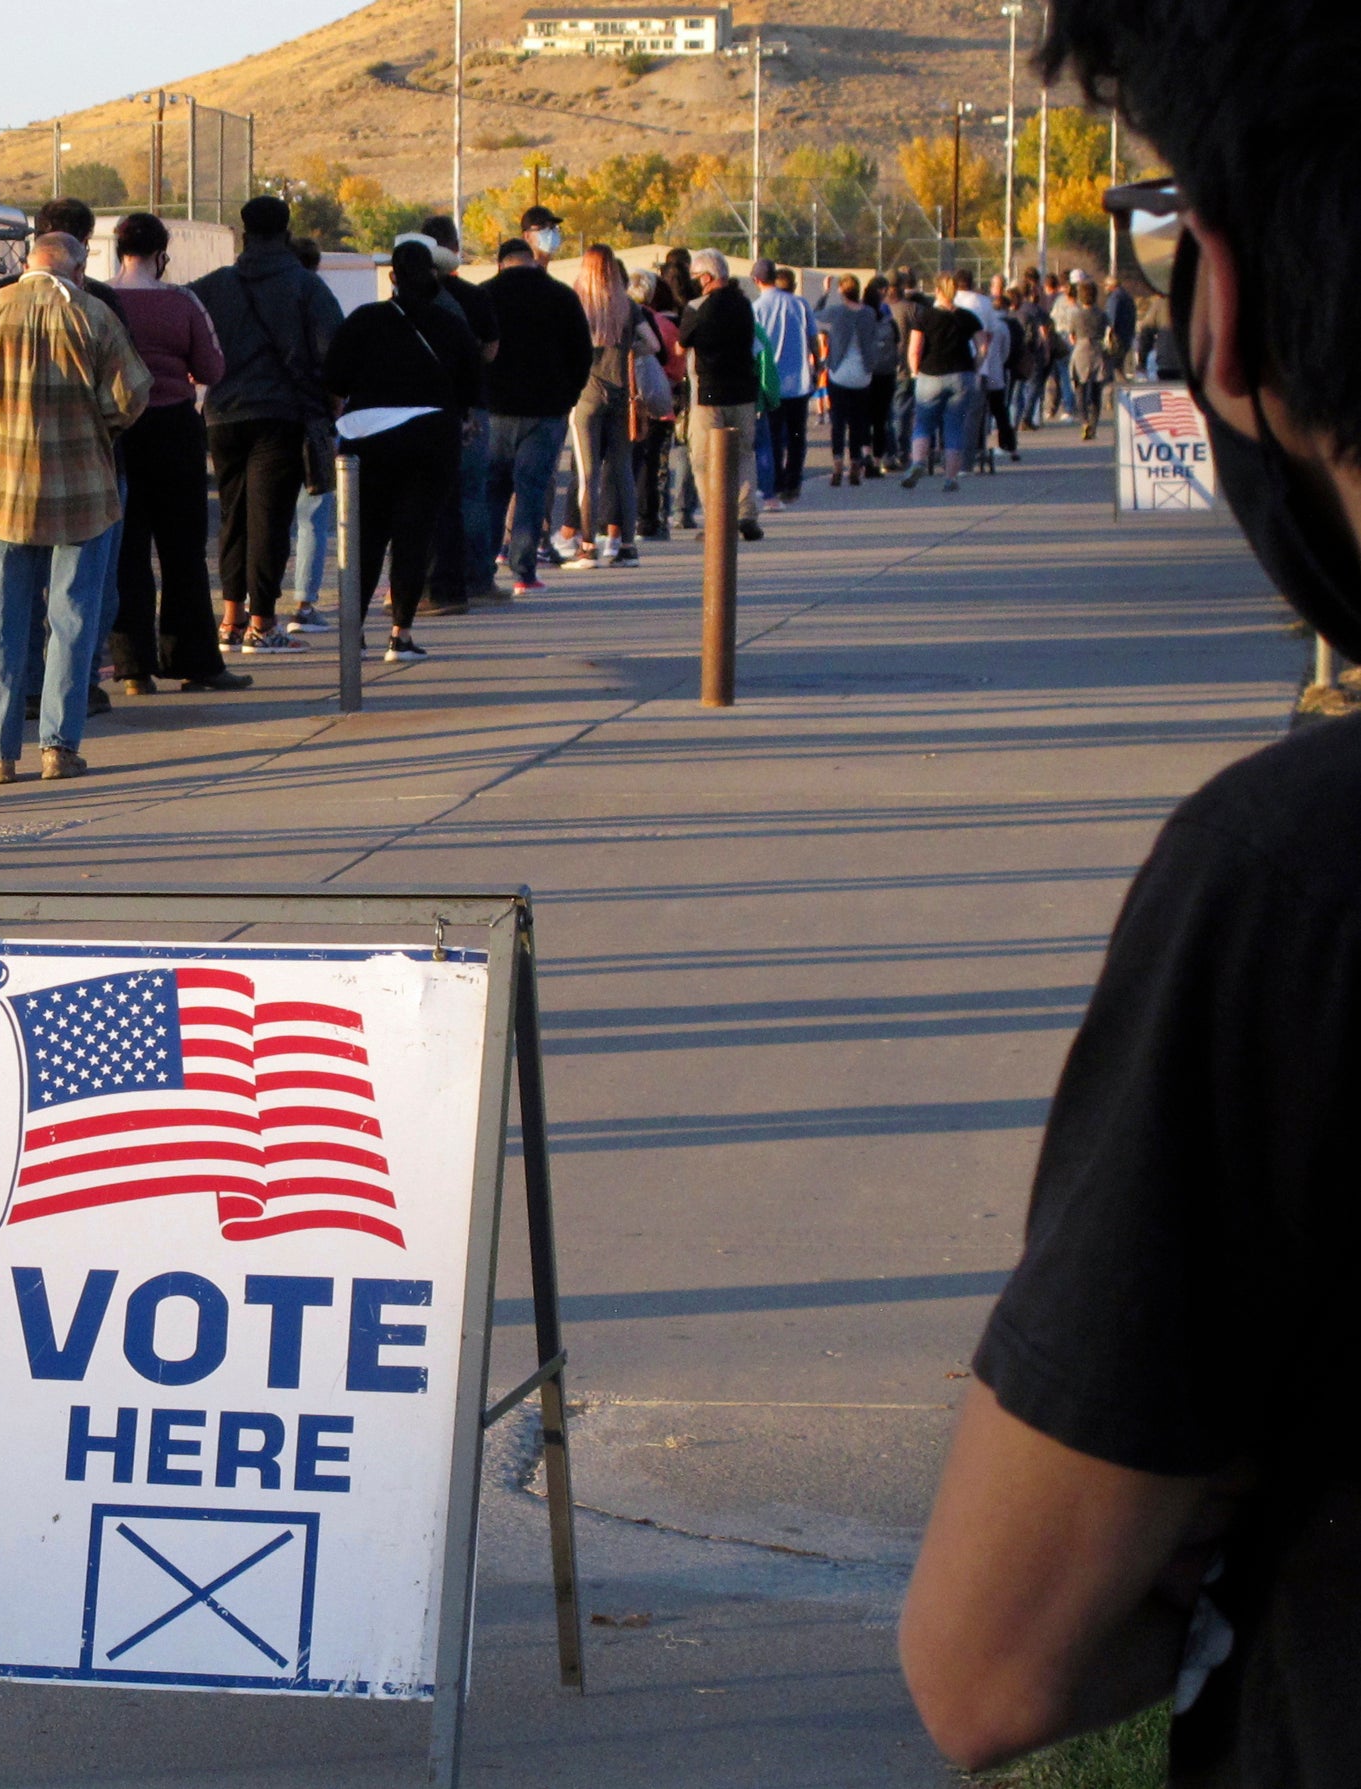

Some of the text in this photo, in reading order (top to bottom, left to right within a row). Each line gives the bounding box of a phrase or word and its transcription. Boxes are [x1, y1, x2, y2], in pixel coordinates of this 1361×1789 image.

[1137, 443, 1207, 461] VOTE
[1148, 465, 1196, 478] HERE
[11, 1266, 433, 1394] VOTE
[65, 1405, 354, 1493] HERE
